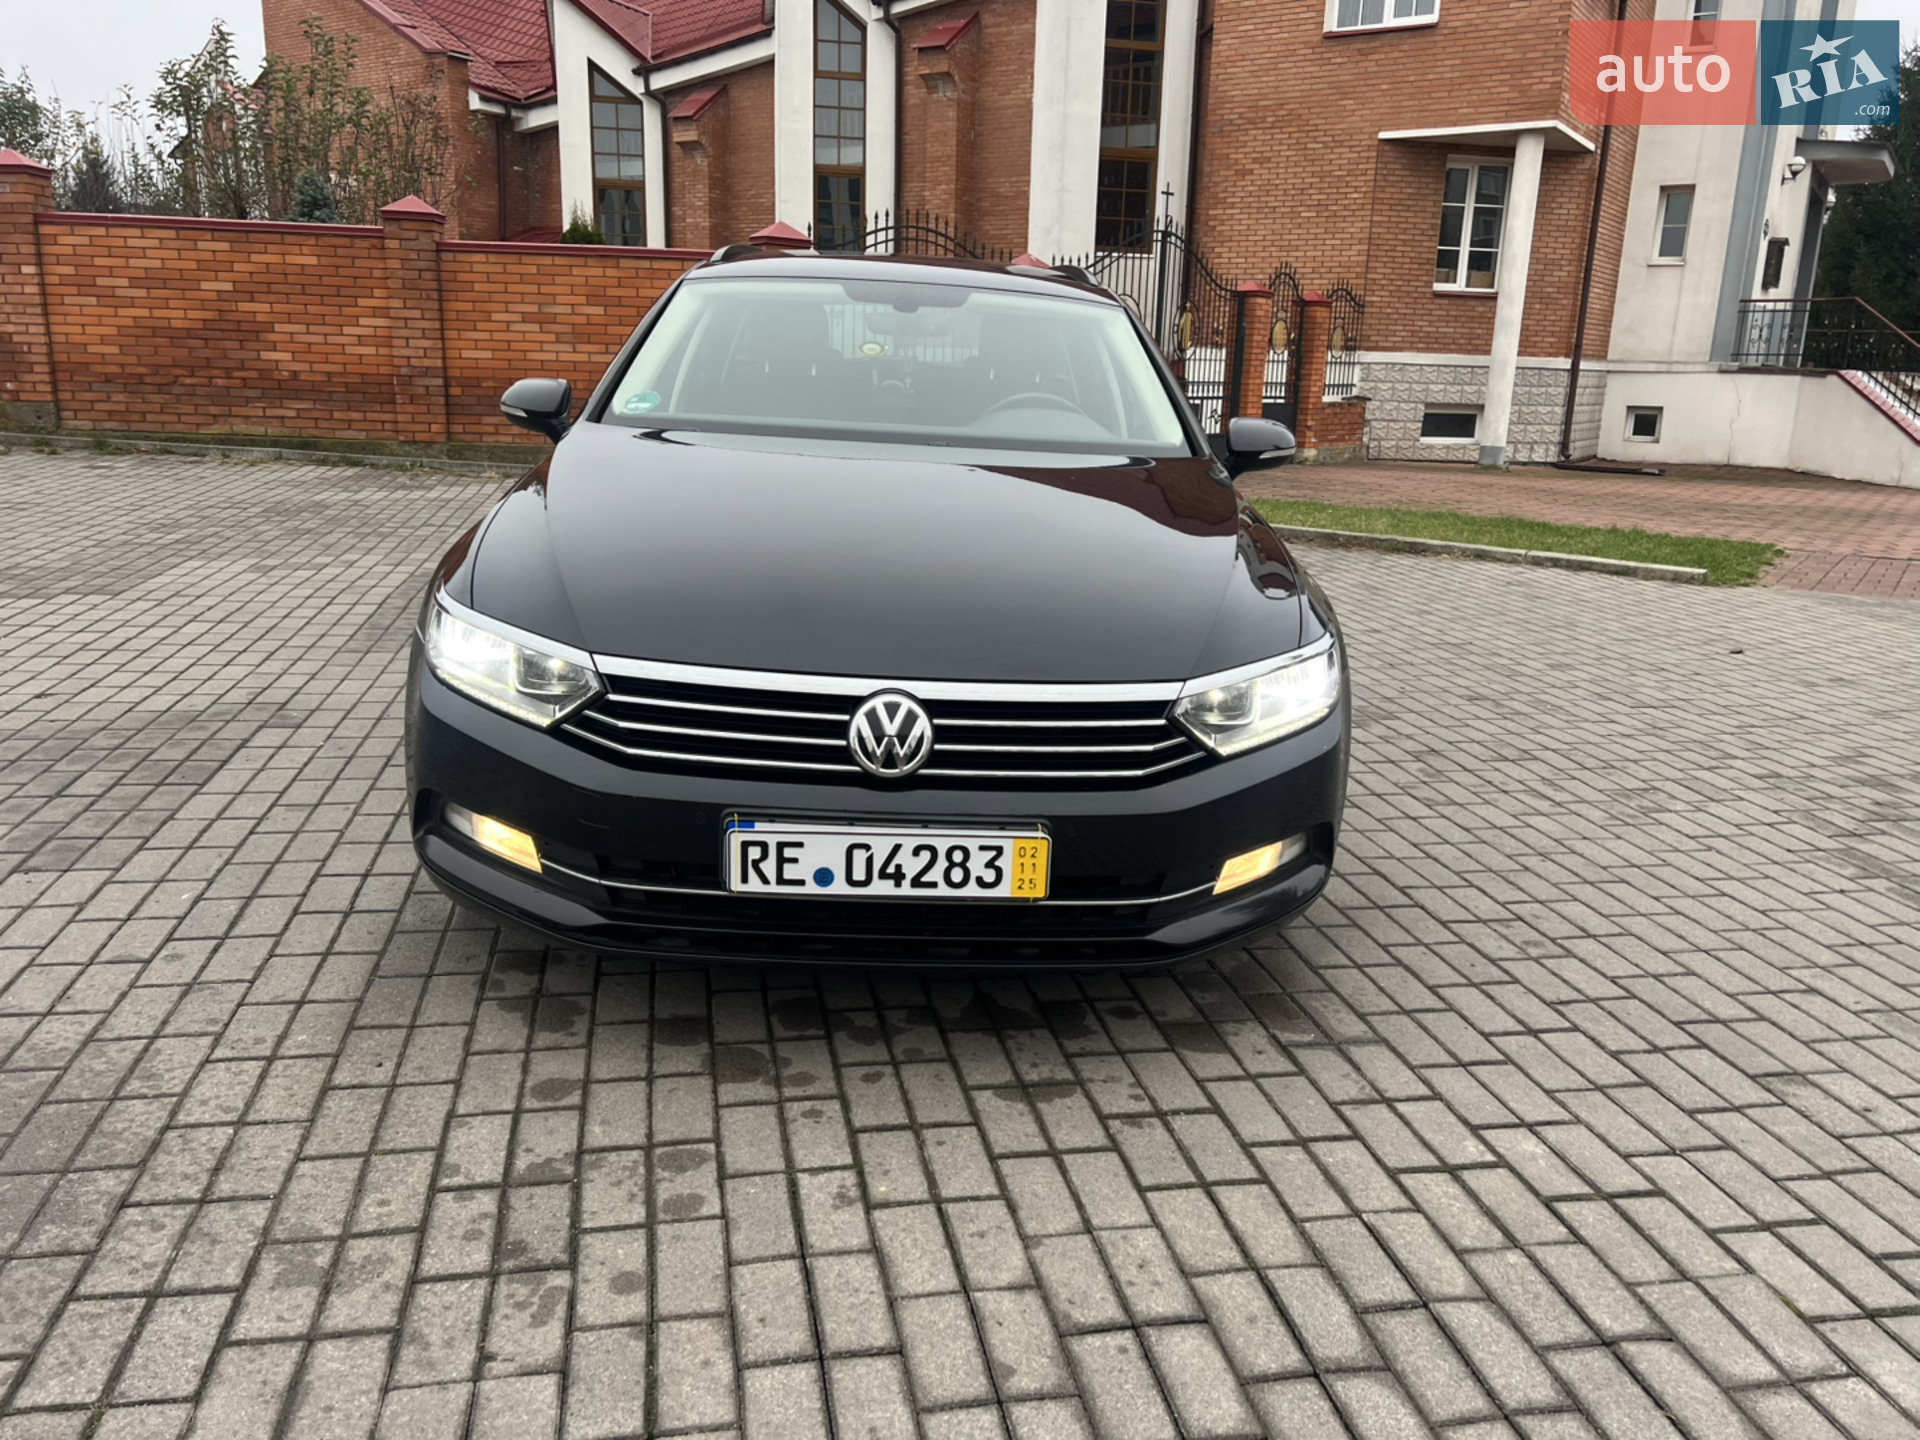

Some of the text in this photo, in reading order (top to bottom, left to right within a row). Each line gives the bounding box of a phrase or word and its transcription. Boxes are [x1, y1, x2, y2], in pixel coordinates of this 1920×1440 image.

[852, 695, 930, 775] VW
[740, 840, 1005, 890] RE 04283
[1018, 846, 1038, 859] 02
